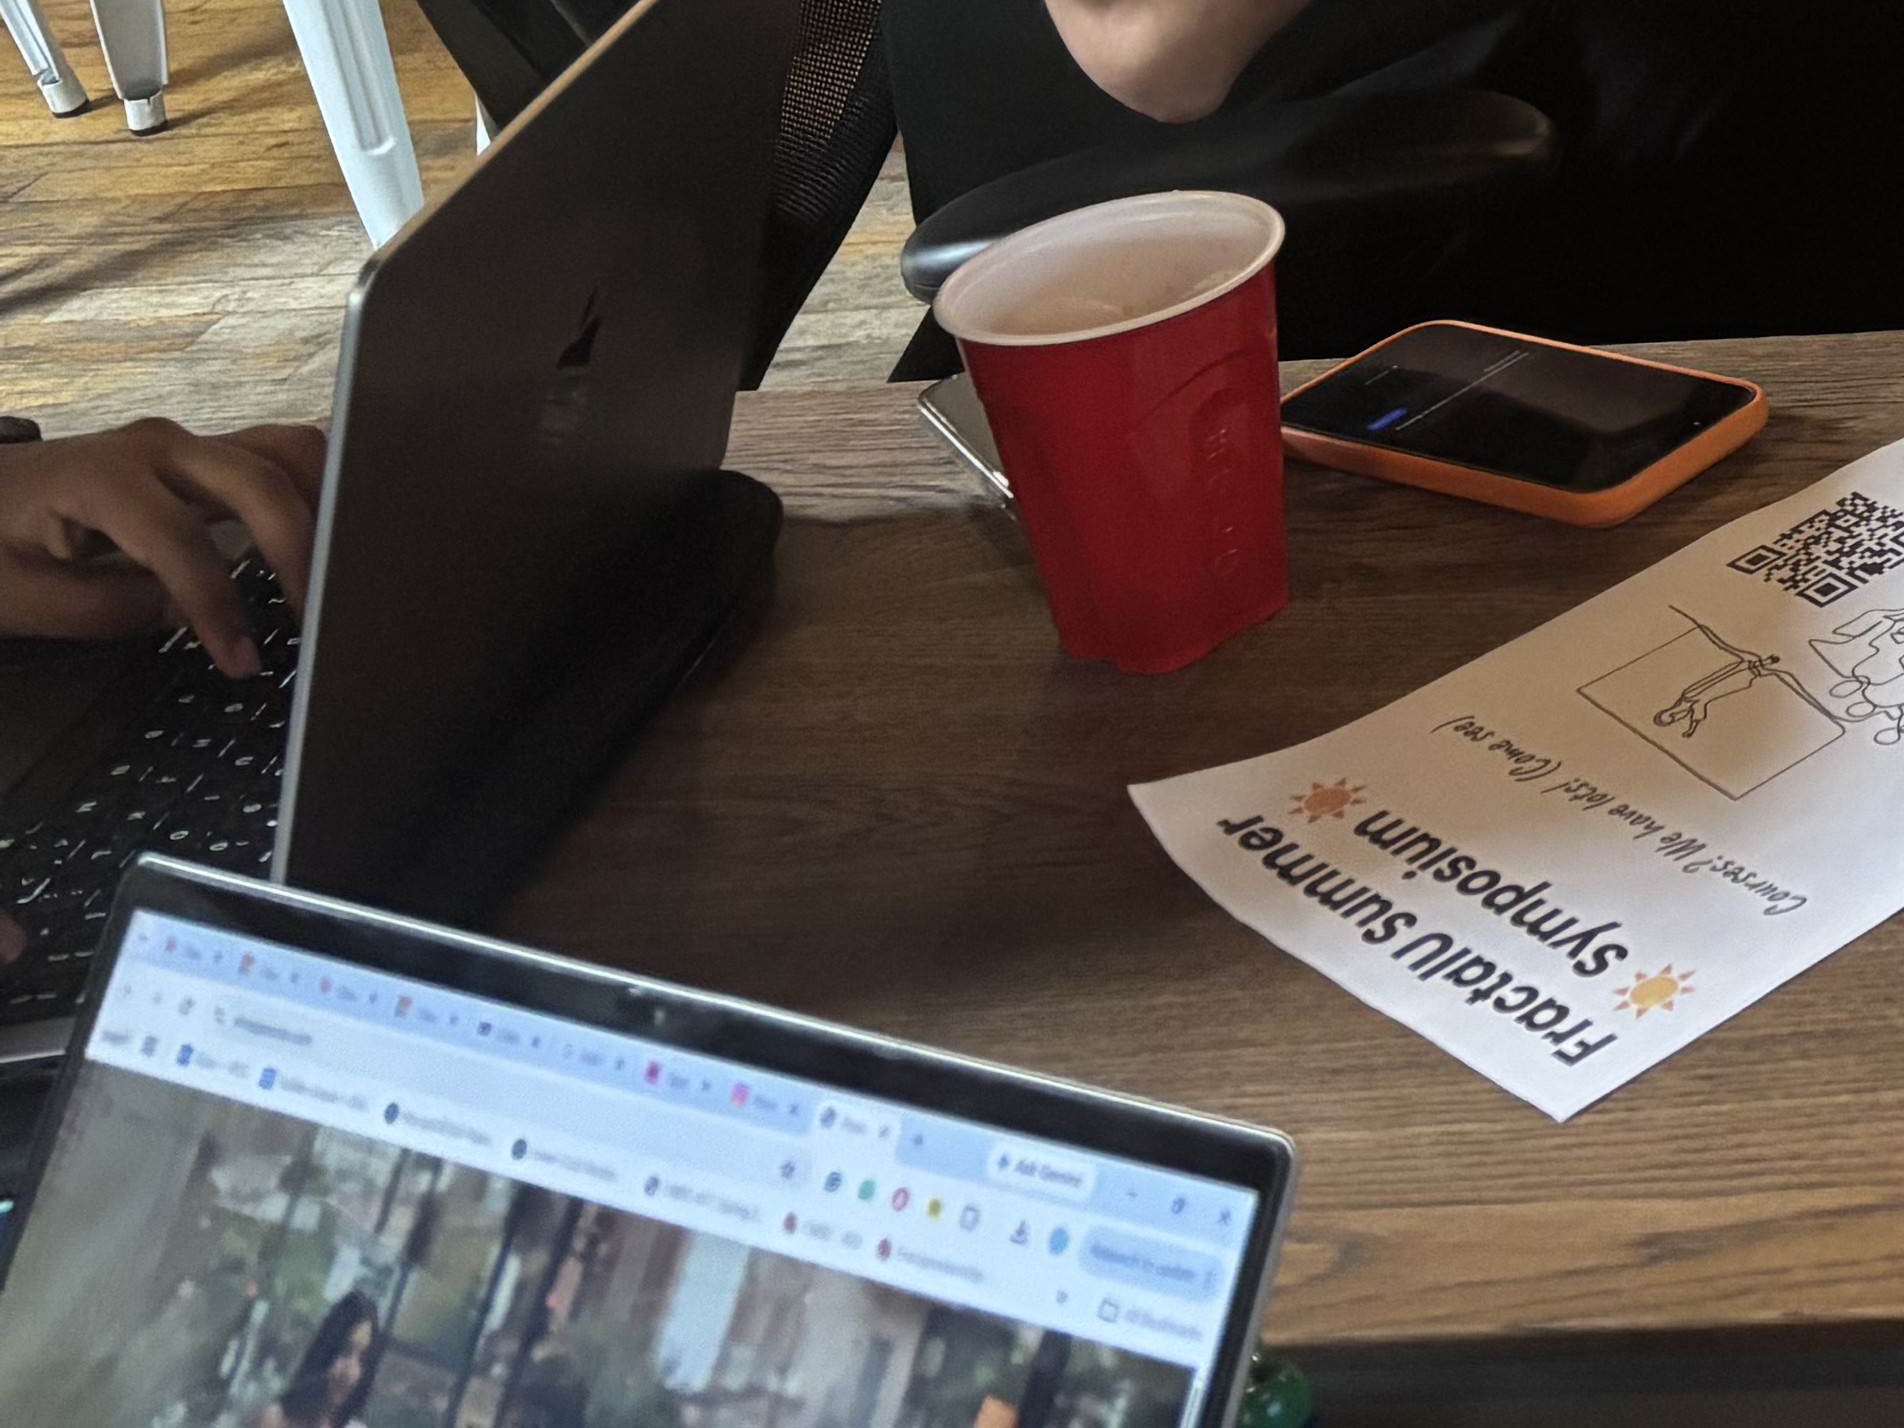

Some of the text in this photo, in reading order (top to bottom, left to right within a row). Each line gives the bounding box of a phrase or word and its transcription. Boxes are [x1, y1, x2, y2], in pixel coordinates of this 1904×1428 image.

[1353, 809, 1629, 978] Symposium
[1430, 715, 1808, 916] Courses? We have lots! (Come see)
[1391, 931, 1619, 1068] FractalU
